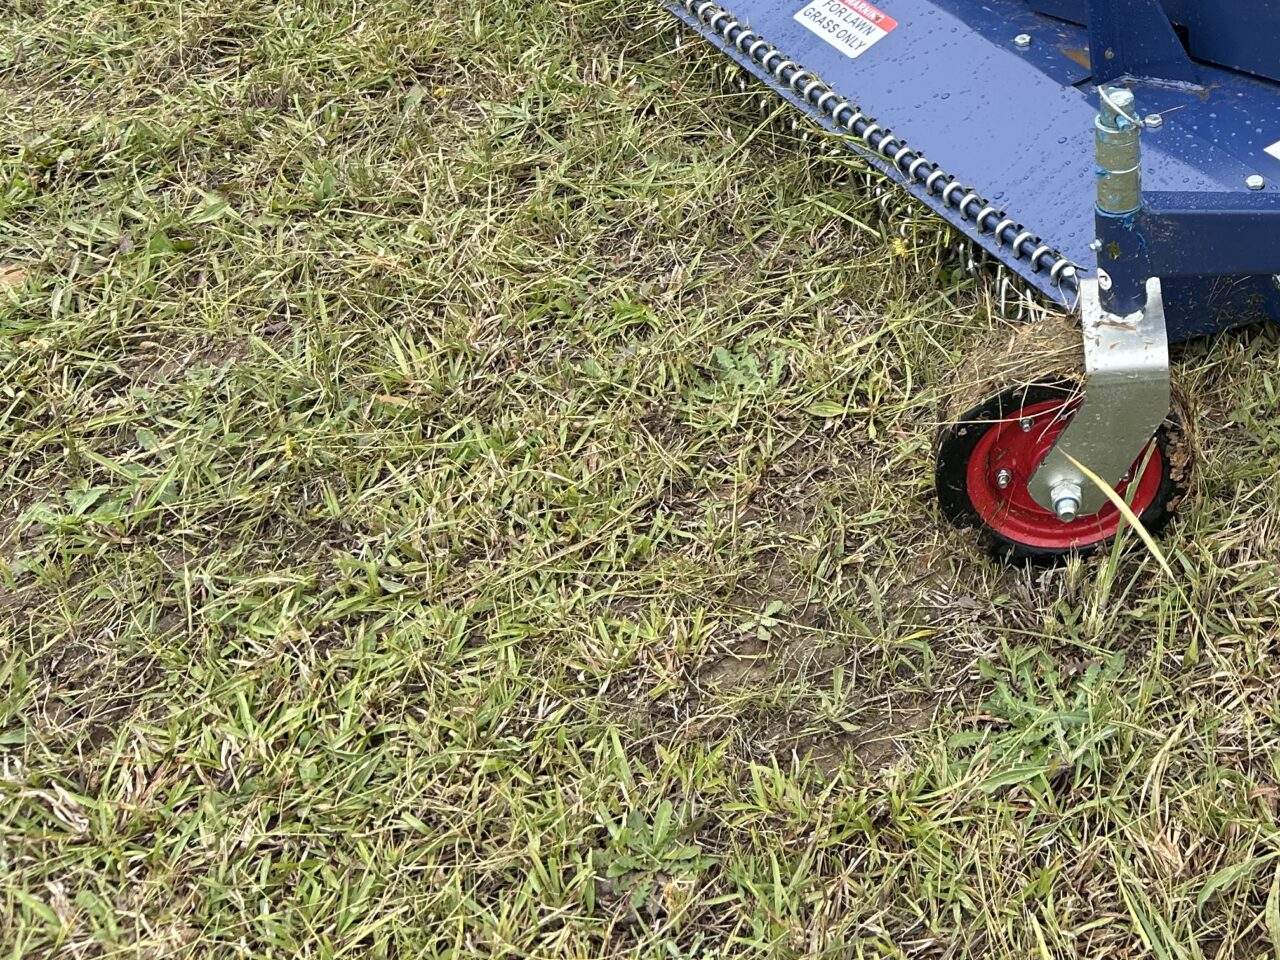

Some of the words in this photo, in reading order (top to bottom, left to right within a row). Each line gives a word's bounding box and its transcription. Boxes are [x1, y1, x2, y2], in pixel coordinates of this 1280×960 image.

[803, 7, 840, 33] GRASS
[836, 29, 868, 51] ONLY
[822, 0, 847, 18] FOR
[842, 11, 877, 36] LAWN
